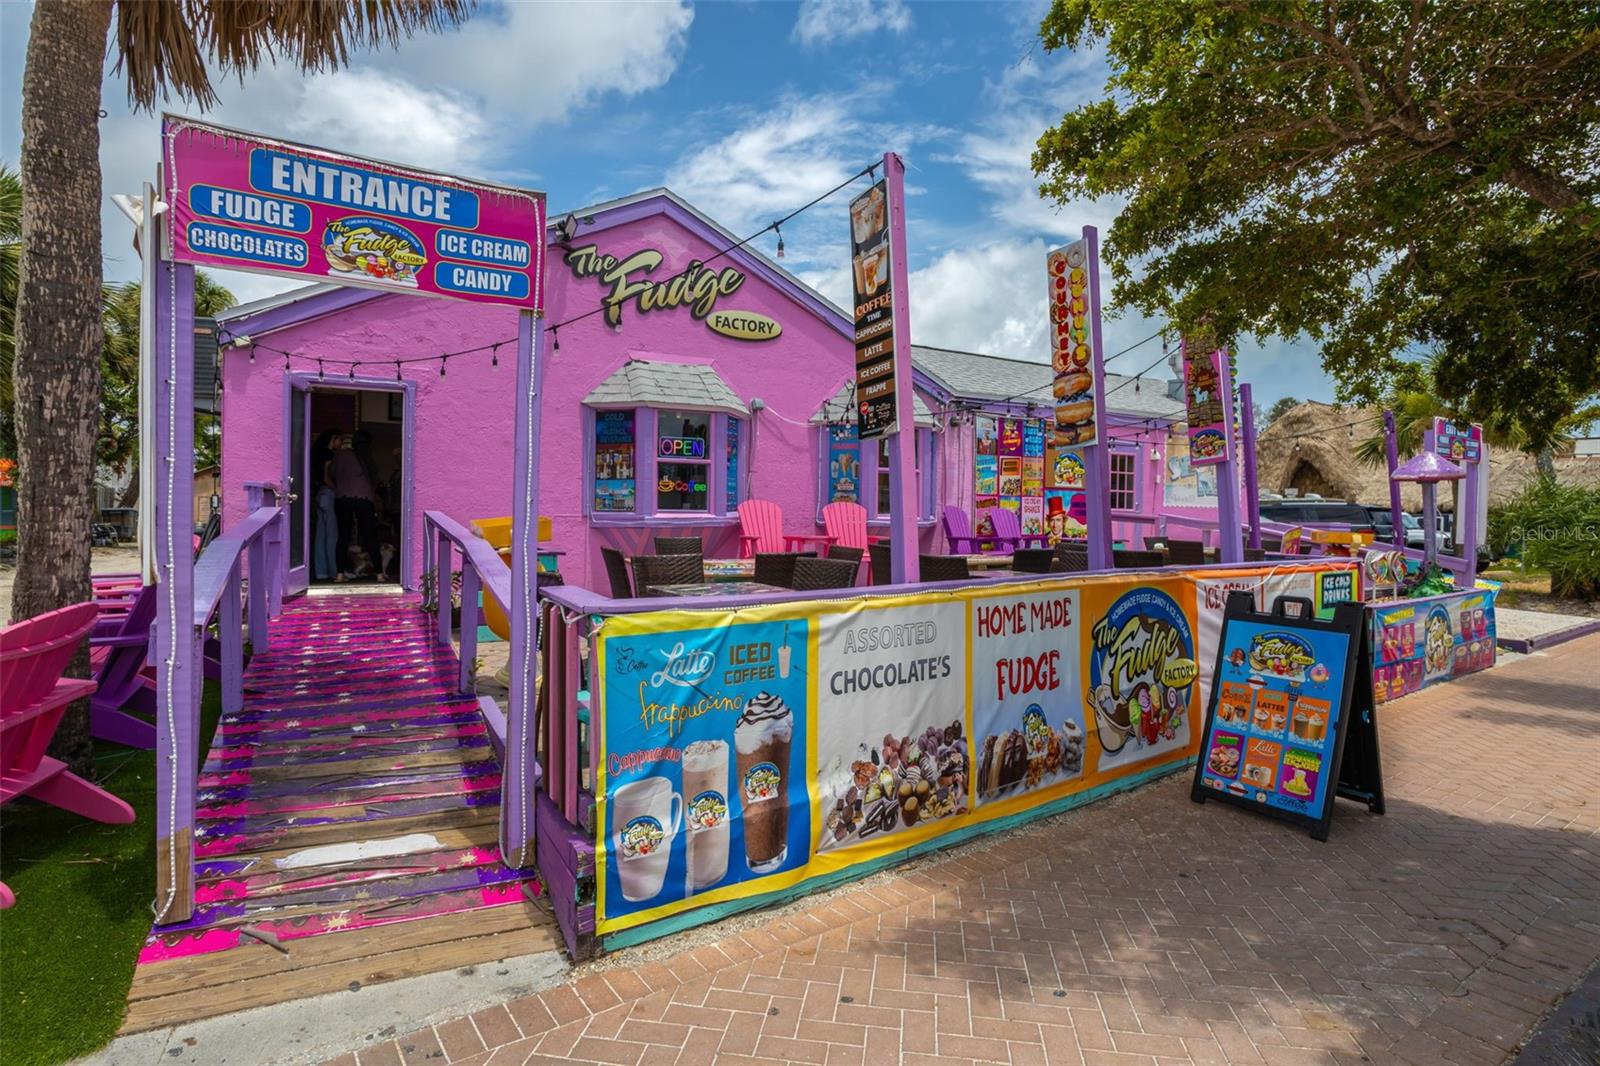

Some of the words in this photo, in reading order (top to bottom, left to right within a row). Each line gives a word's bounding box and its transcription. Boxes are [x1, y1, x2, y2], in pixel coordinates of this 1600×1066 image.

[272, 157, 451, 221] ENTRANCE
[210, 190, 295, 228] FUDGE
[327, 221, 350, 233] The
[342, 227, 411, 257] Fudge
[191, 228, 305, 262] CHOCOLATES
[440, 233, 468, 254] ICE
[470, 240, 527, 263] CREAM
[567, 245, 618, 276] The
[452, 268, 513, 292] CANDY
[601, 250, 746, 327] Fudge
[855, 293, 892, 316] COFFEE
[714, 315, 775, 334] FACTORY
[855, 319, 892, 339] CAPPUCCINO
[864, 343, 883, 357] LATTE
[860, 368, 869, 378] ICE
[870, 361, 891, 376] COFFEE
[661, 440, 703, 455] OPEN
[674, 480, 706, 492] Coffee
[977, 601, 1027, 638] HOME
[1030, 597, 1072, 633] MADE
[843, 620, 937, 655] ASSORTED
[1093, 617, 1118, 649] The
[651, 641, 716, 688] Latte
[729, 641, 772, 666] ICED
[1110, 615, 1181, 698] Fudge
[723, 665, 775, 686] COFFEE
[830, 655, 951, 696] CHOCOLATE'S
[995, 650, 1060, 700] FUDGE
[1164, 664, 1196, 683] FACTORY
